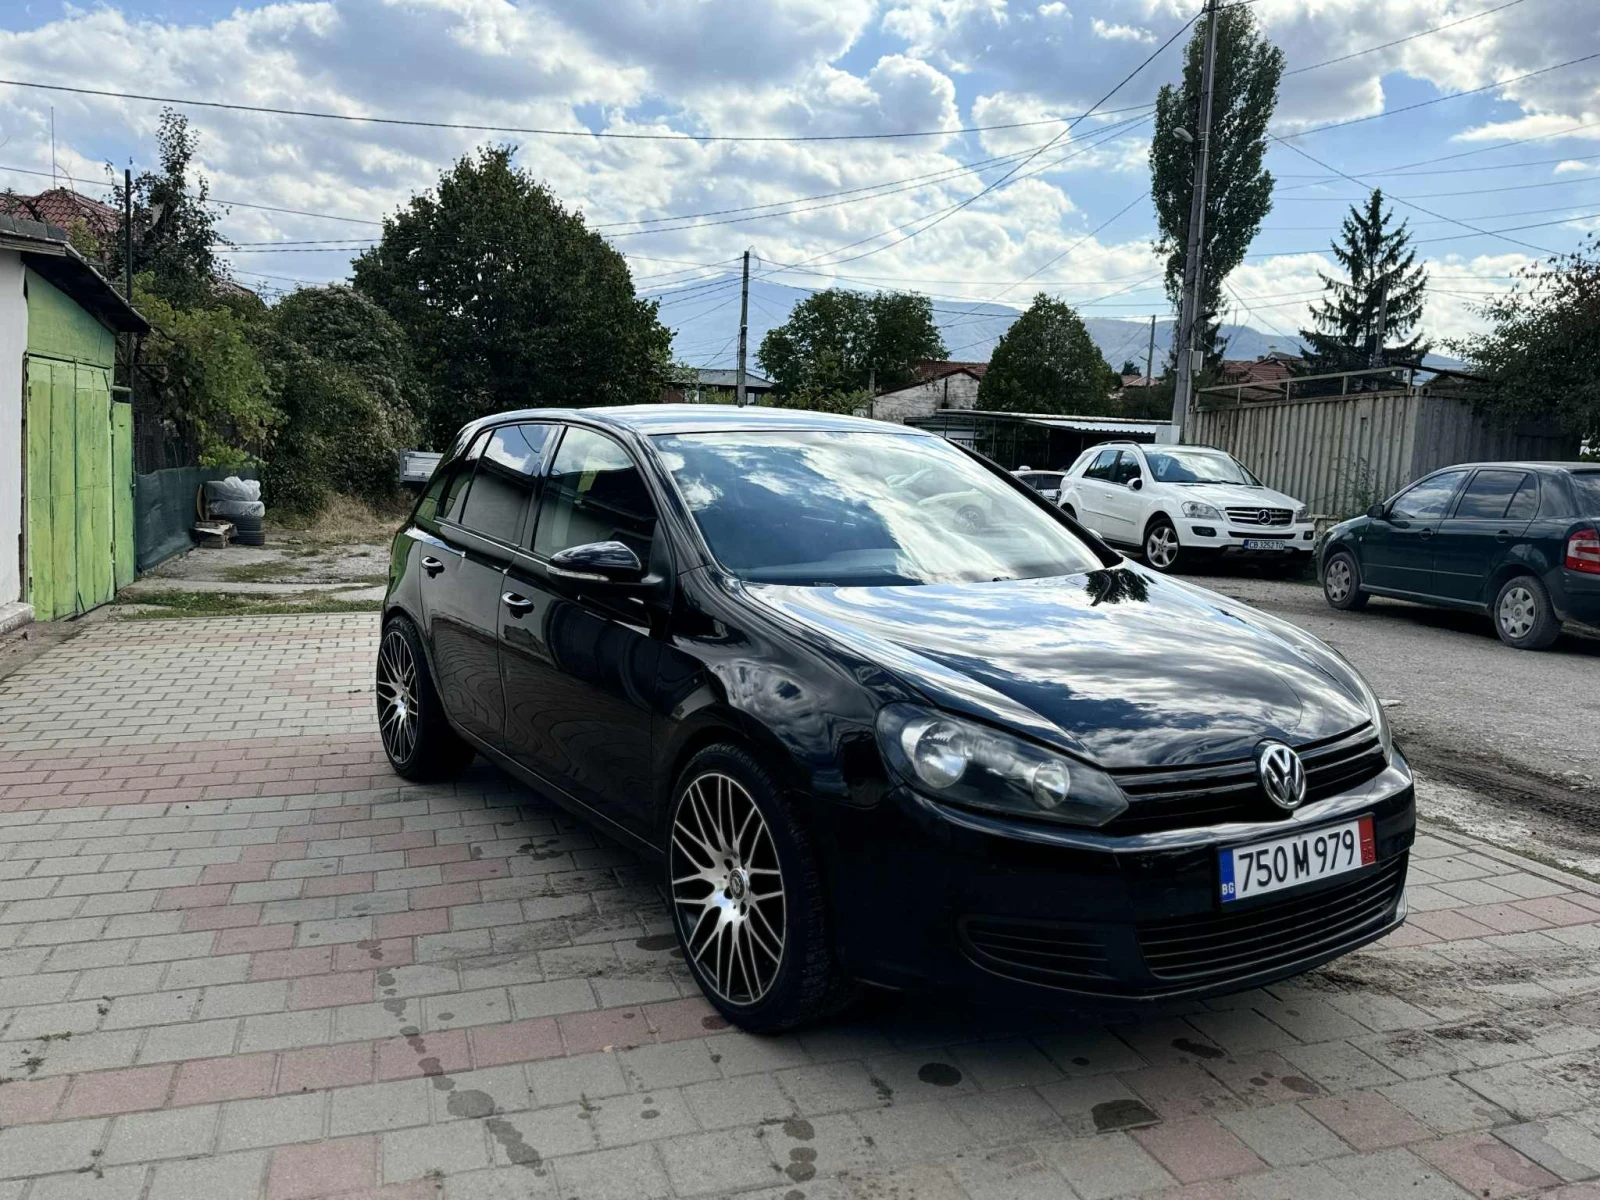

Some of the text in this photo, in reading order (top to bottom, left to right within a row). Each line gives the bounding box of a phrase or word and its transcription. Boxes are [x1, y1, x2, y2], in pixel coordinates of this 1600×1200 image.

[1239, 846, 1288, 891] 750
[1292, 839, 1310, 878] M
[1314, 829, 1355, 873] 979
[1222, 882, 1235, 895] BG
